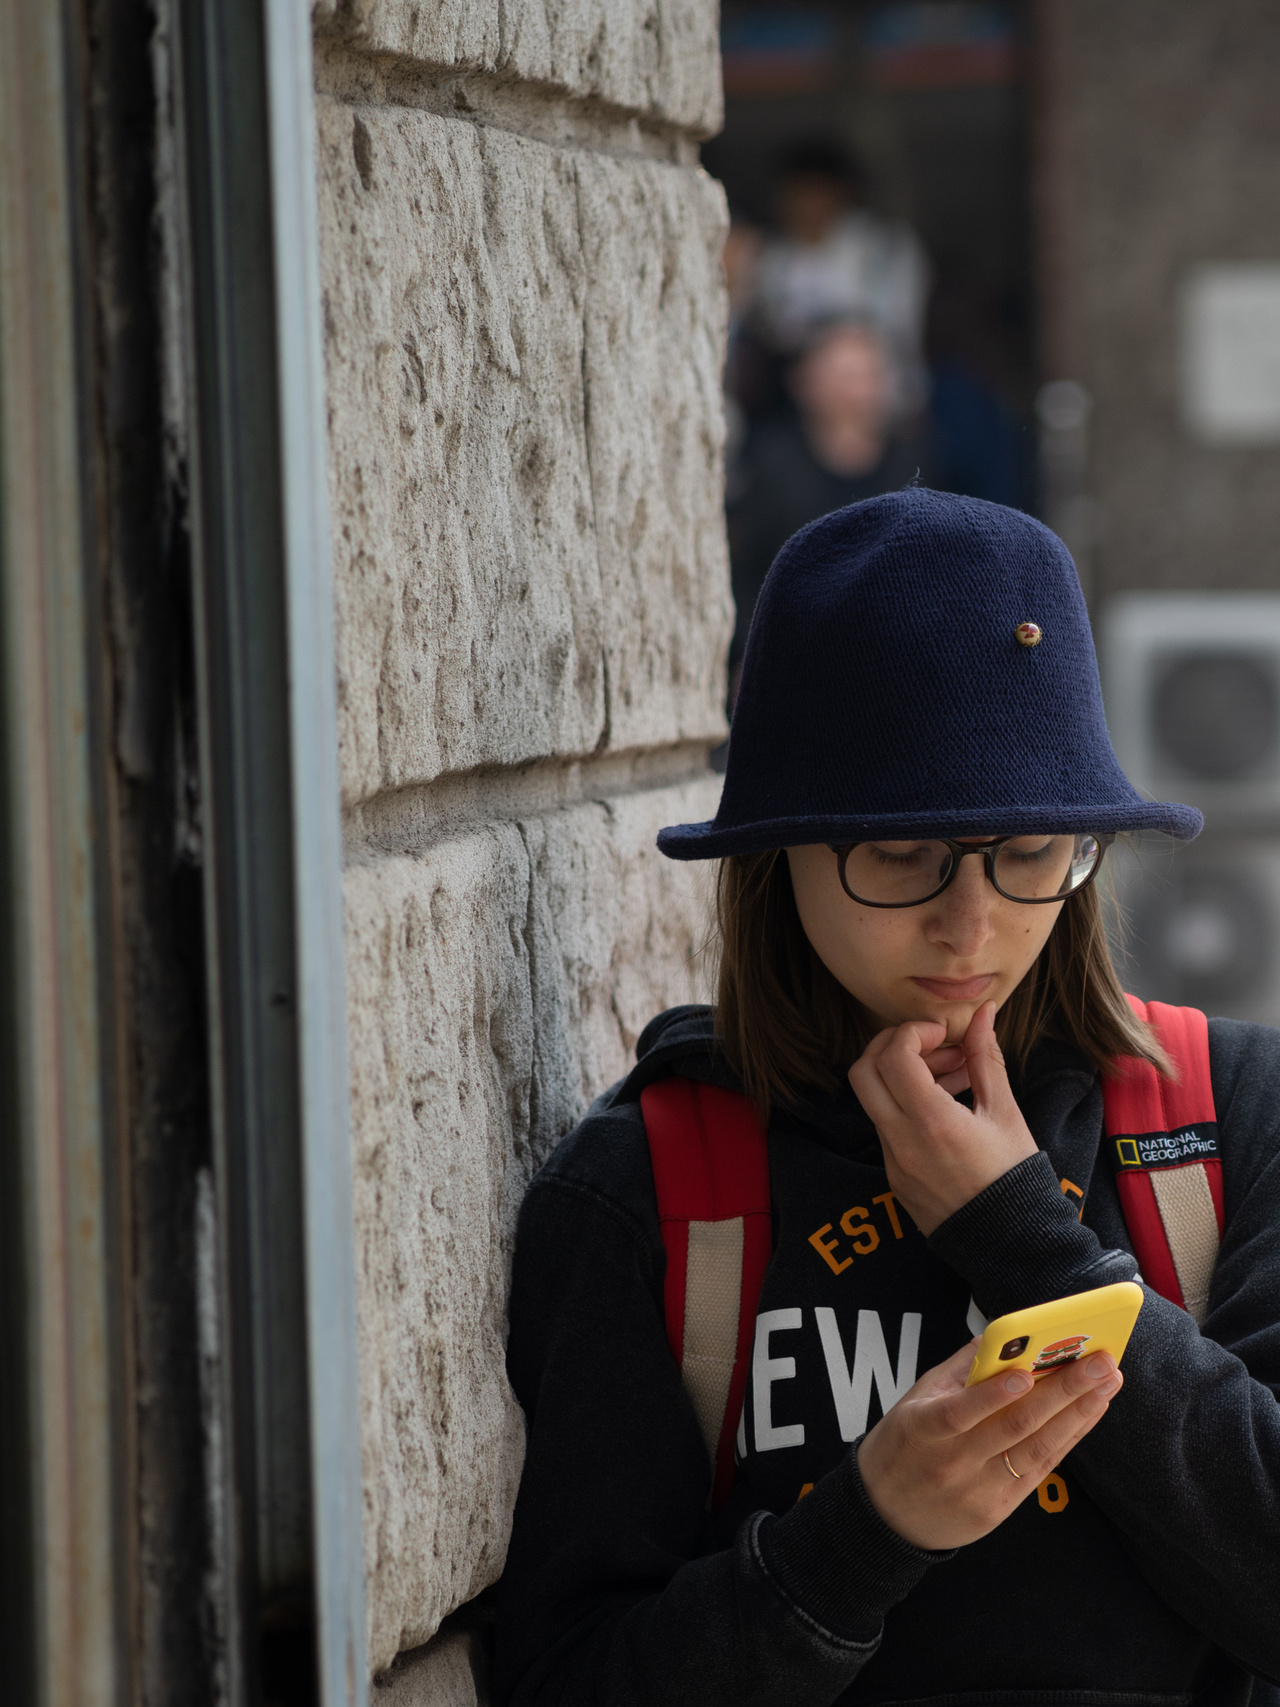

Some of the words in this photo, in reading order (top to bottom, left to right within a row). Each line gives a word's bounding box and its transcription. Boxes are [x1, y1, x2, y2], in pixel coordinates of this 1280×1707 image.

[1138, 1131, 1201, 1152] NATIONAL
[1141, 1140, 1217, 1162] GEOGRAPHIC
[734, 1306, 923, 1466] EW
